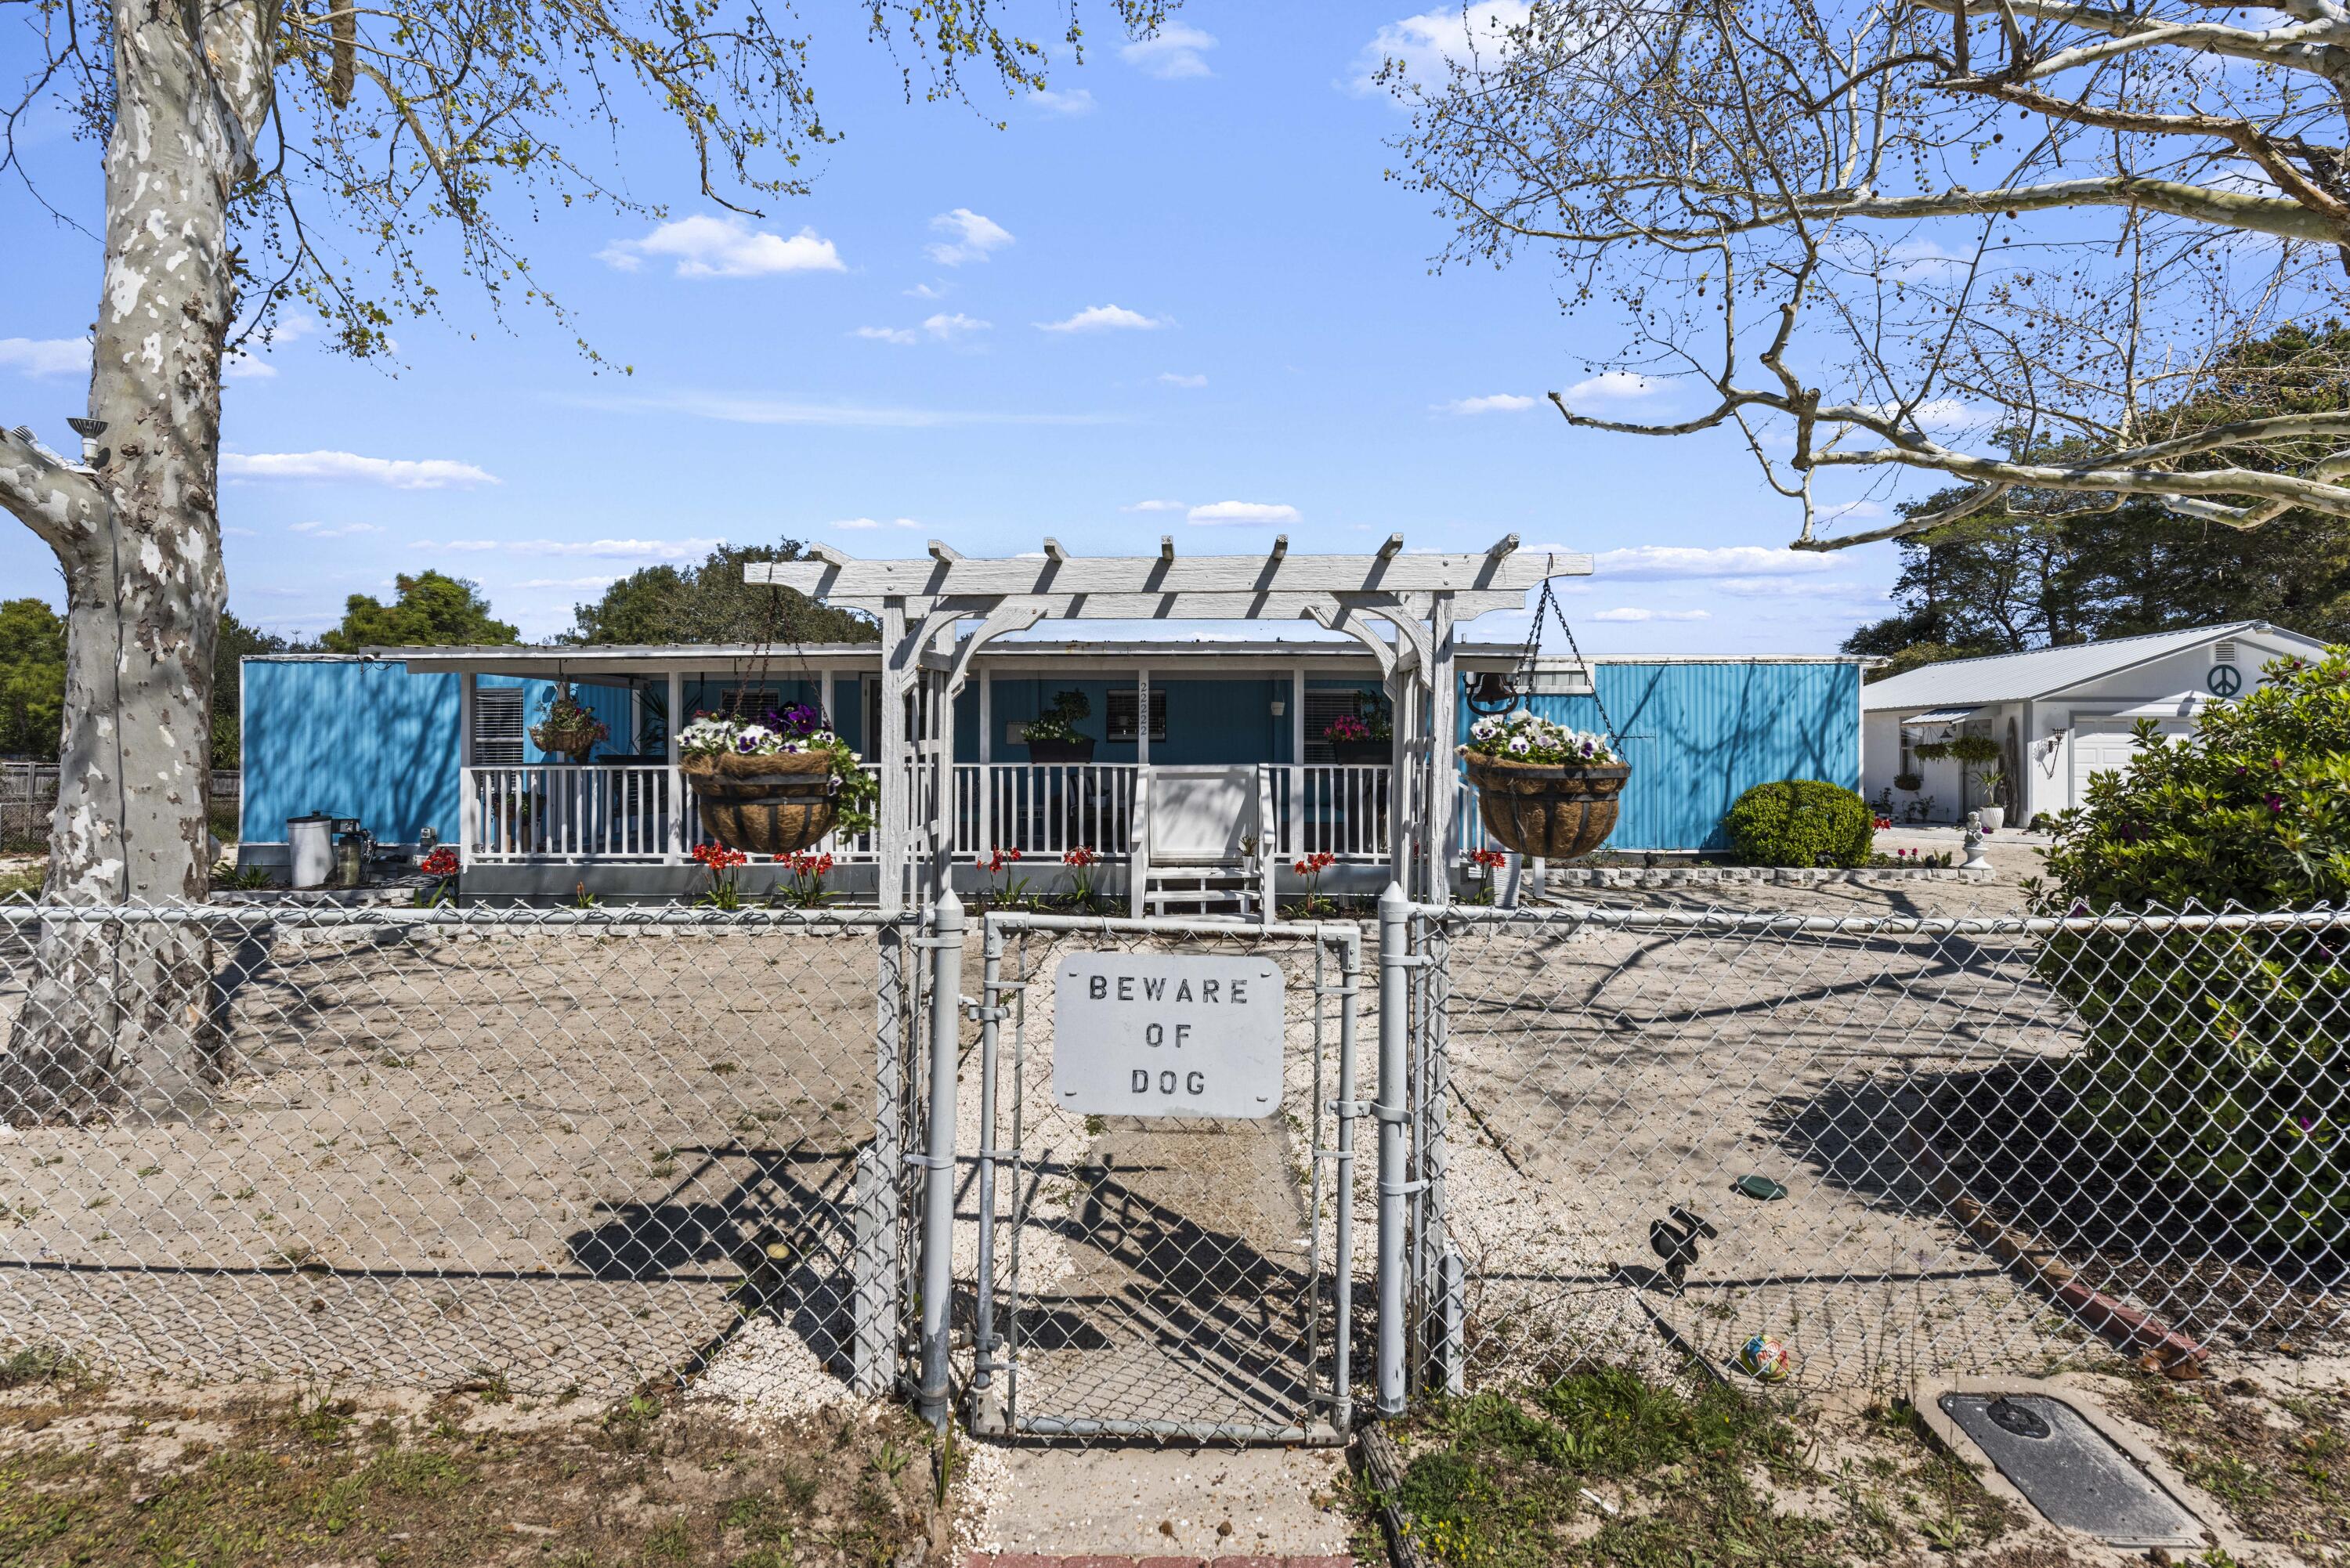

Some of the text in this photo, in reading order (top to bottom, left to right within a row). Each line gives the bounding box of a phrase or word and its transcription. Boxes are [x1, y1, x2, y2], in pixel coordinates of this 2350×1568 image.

[1090, 975, 1247, 1003] BEWARE
[1145, 1023, 1191, 1048] OF
[1132, 1069, 1205, 1095] DOG
